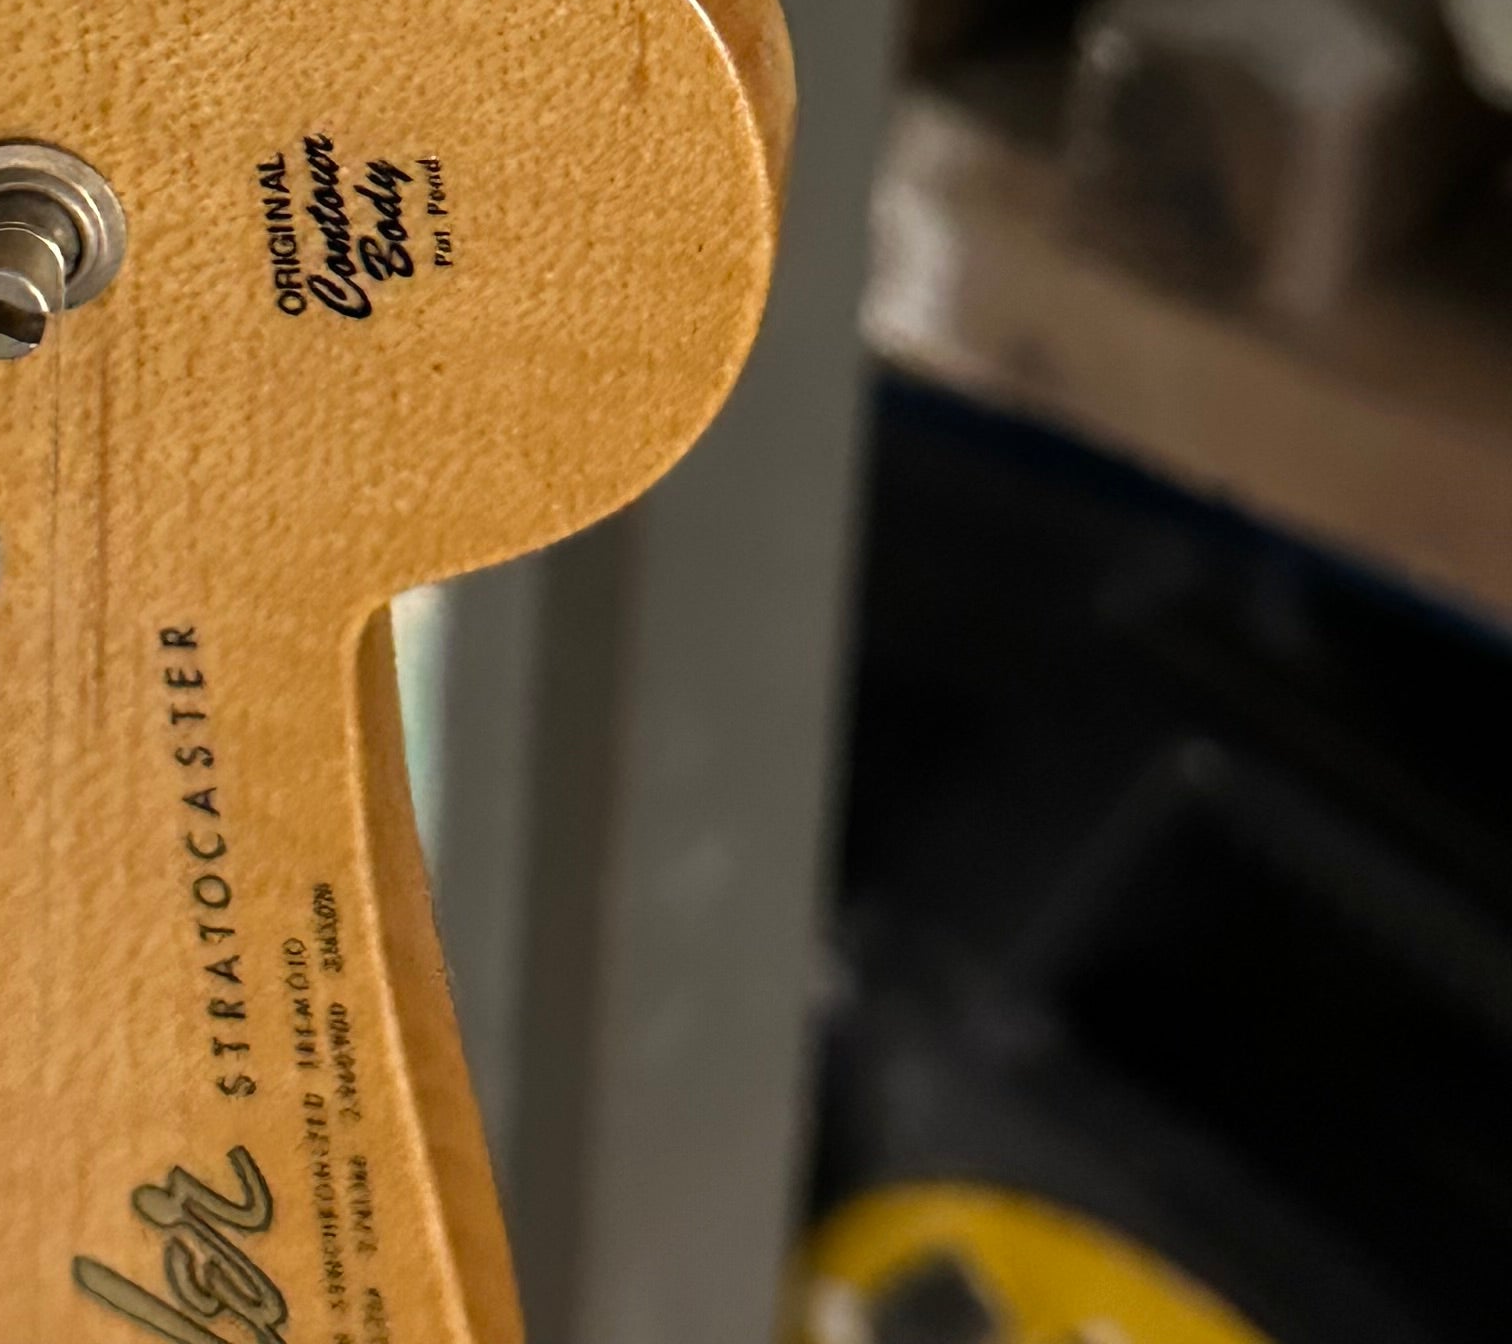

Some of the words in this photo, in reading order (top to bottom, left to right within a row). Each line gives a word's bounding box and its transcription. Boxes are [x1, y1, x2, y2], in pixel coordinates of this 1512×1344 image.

[256, 151, 308, 317] ORIGINAL
[303, 132, 373, 320] Contour
[353, 159, 414, 282] Body
[160, 623, 257, 1100] STRATOCASTER
